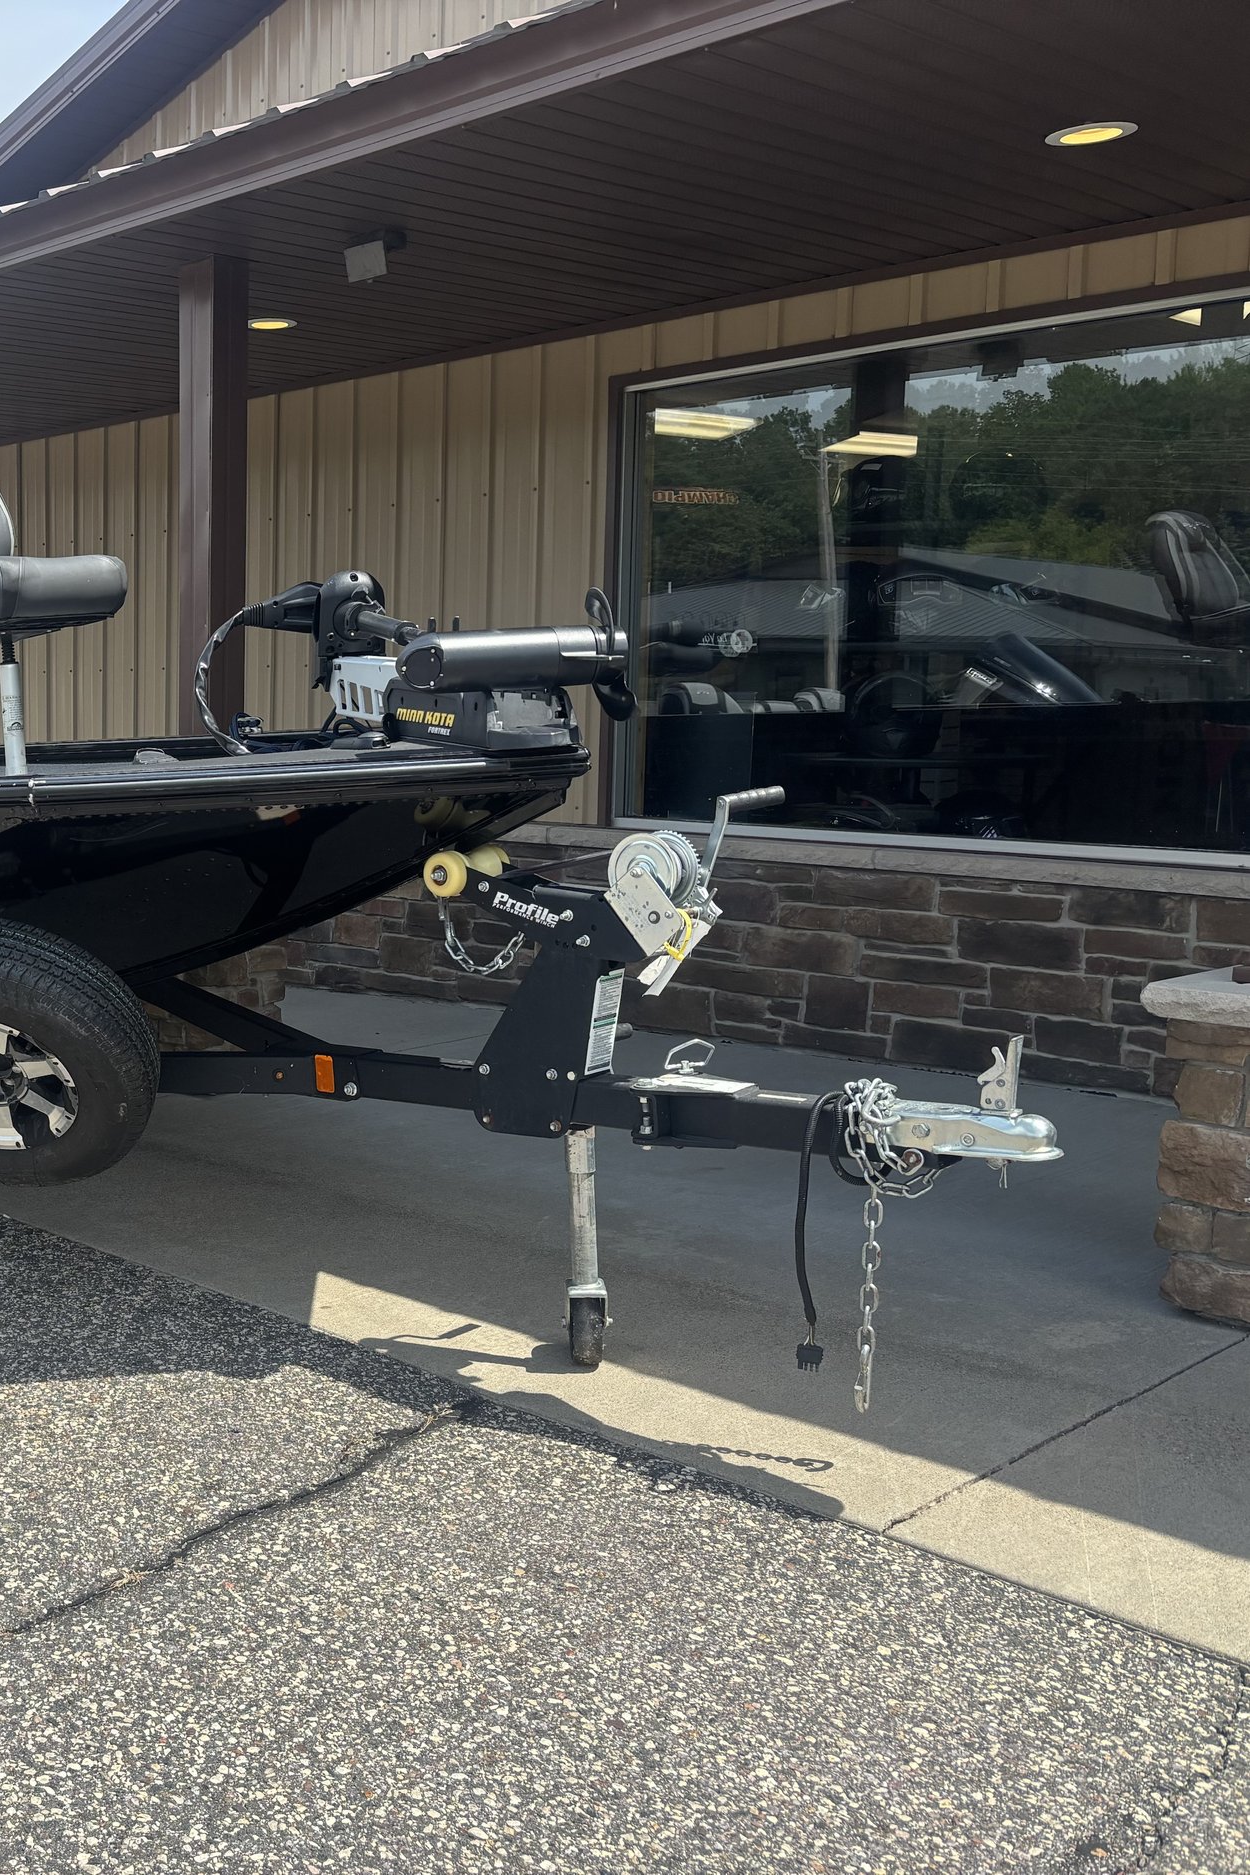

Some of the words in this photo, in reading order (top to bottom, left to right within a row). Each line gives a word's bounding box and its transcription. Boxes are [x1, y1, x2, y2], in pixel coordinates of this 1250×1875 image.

[652, 490, 740, 504] CHAMPIO
[396, 708, 424, 723] MINN
[424, 711, 455, 727] KOTA
[427, 726, 451, 736] FORTREX
[492, 903, 534, 921] PERFORMANCE
[535, 917, 556, 928] WINCH
[493, 891, 559, 925] Profile
